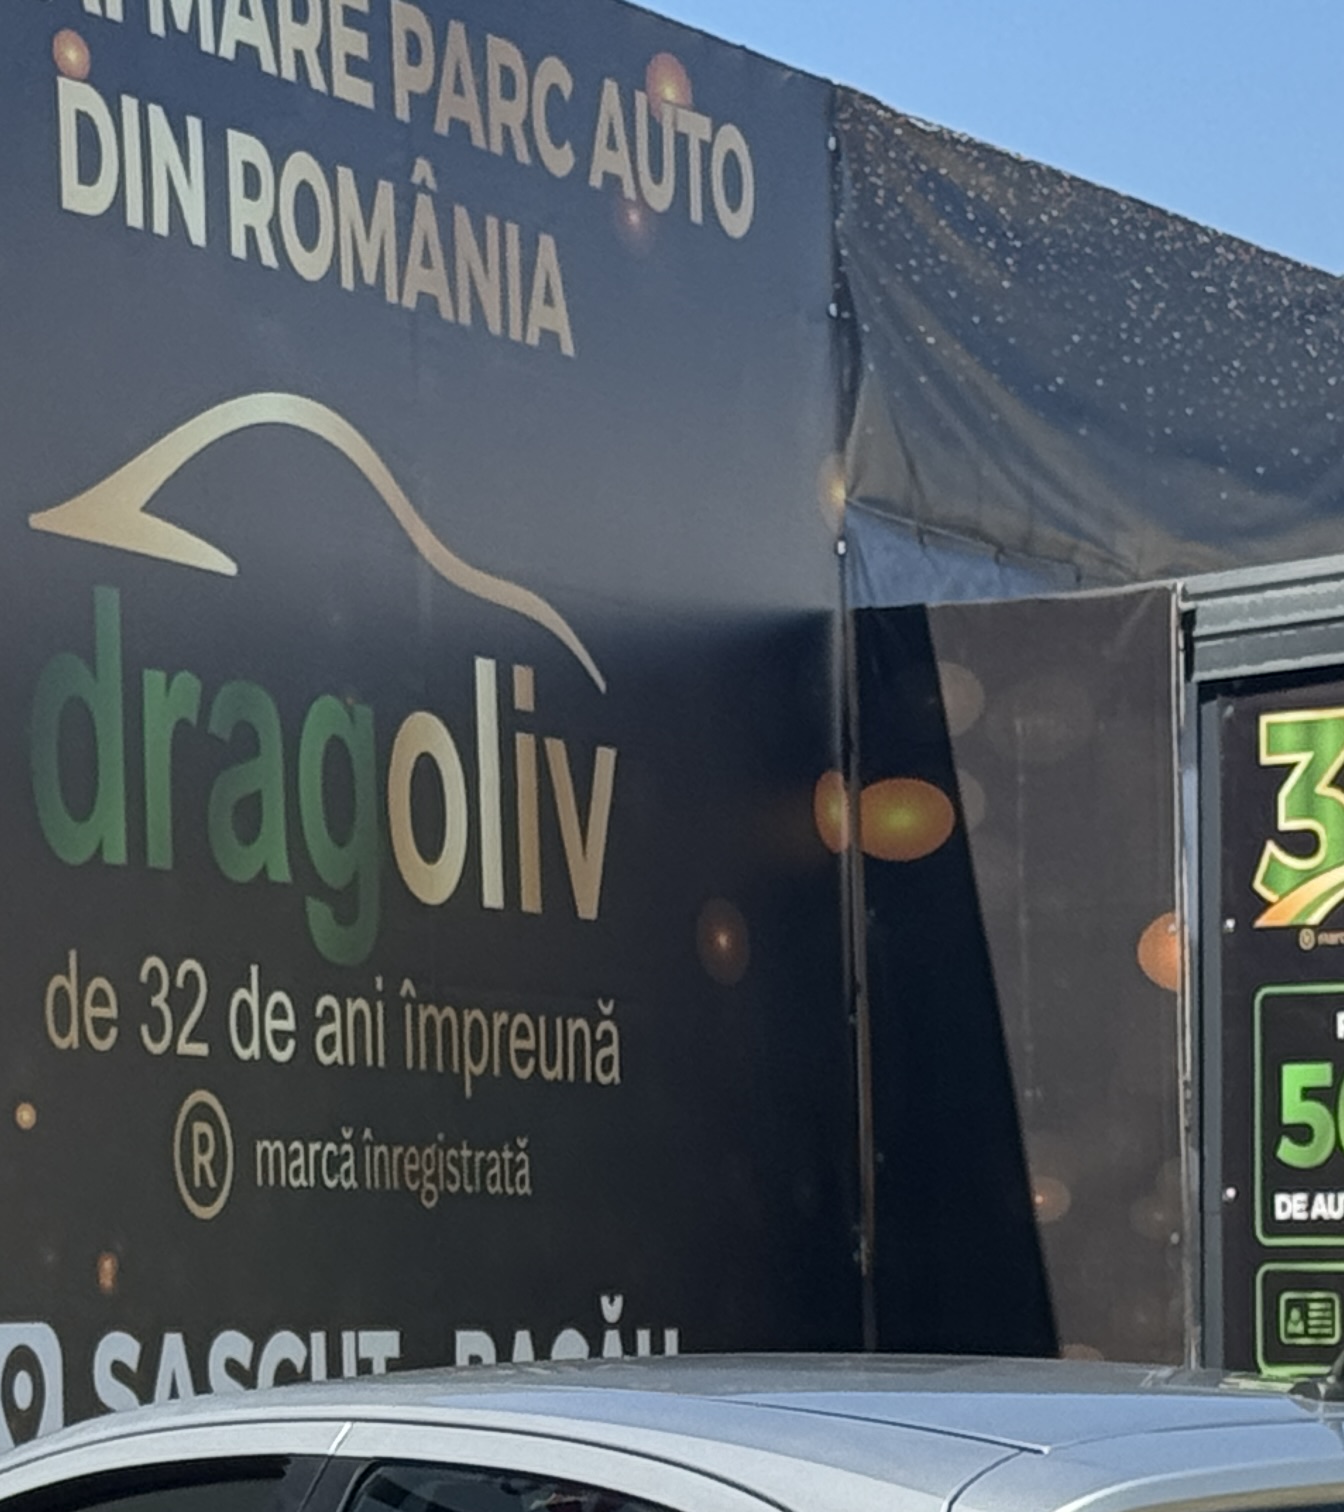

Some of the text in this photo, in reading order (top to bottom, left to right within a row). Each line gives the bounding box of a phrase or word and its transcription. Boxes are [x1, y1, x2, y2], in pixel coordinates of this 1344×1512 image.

[391, 2, 756, 238] PARC AUTO
[57, 76, 576, 358] DIN ROMÂNIA
[30, 586, 618, 967] dragoliv
[45, 948, 621, 1099] de 32 de ani împreună
[256, 1127, 357, 1191] marcă
[363, 1130, 533, 1209] înregistrată
[1273, 1192, 1312, 1222] DE
